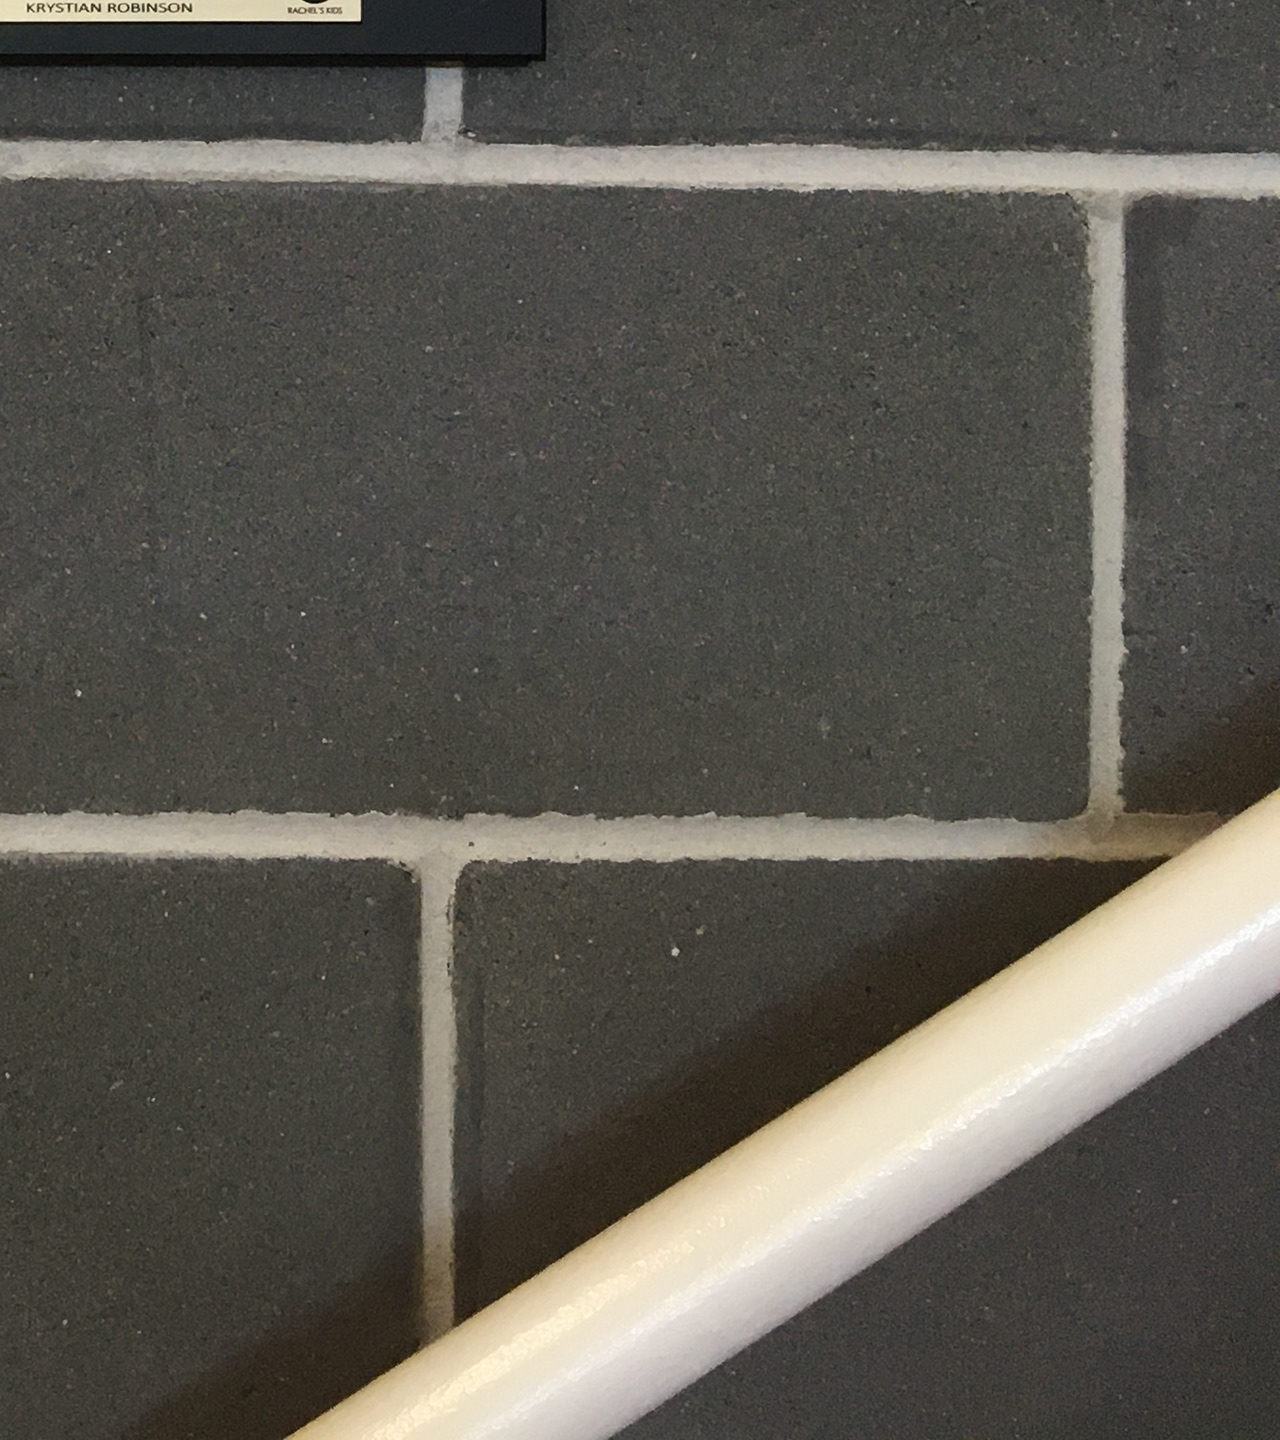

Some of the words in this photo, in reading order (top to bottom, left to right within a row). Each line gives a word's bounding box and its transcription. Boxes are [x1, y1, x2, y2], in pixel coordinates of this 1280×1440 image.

[26, 2, 102, 13] KRYSTIAN
[107, 2, 193, 13] ROBINSON
[326, 6, 343, 14] KIDS
